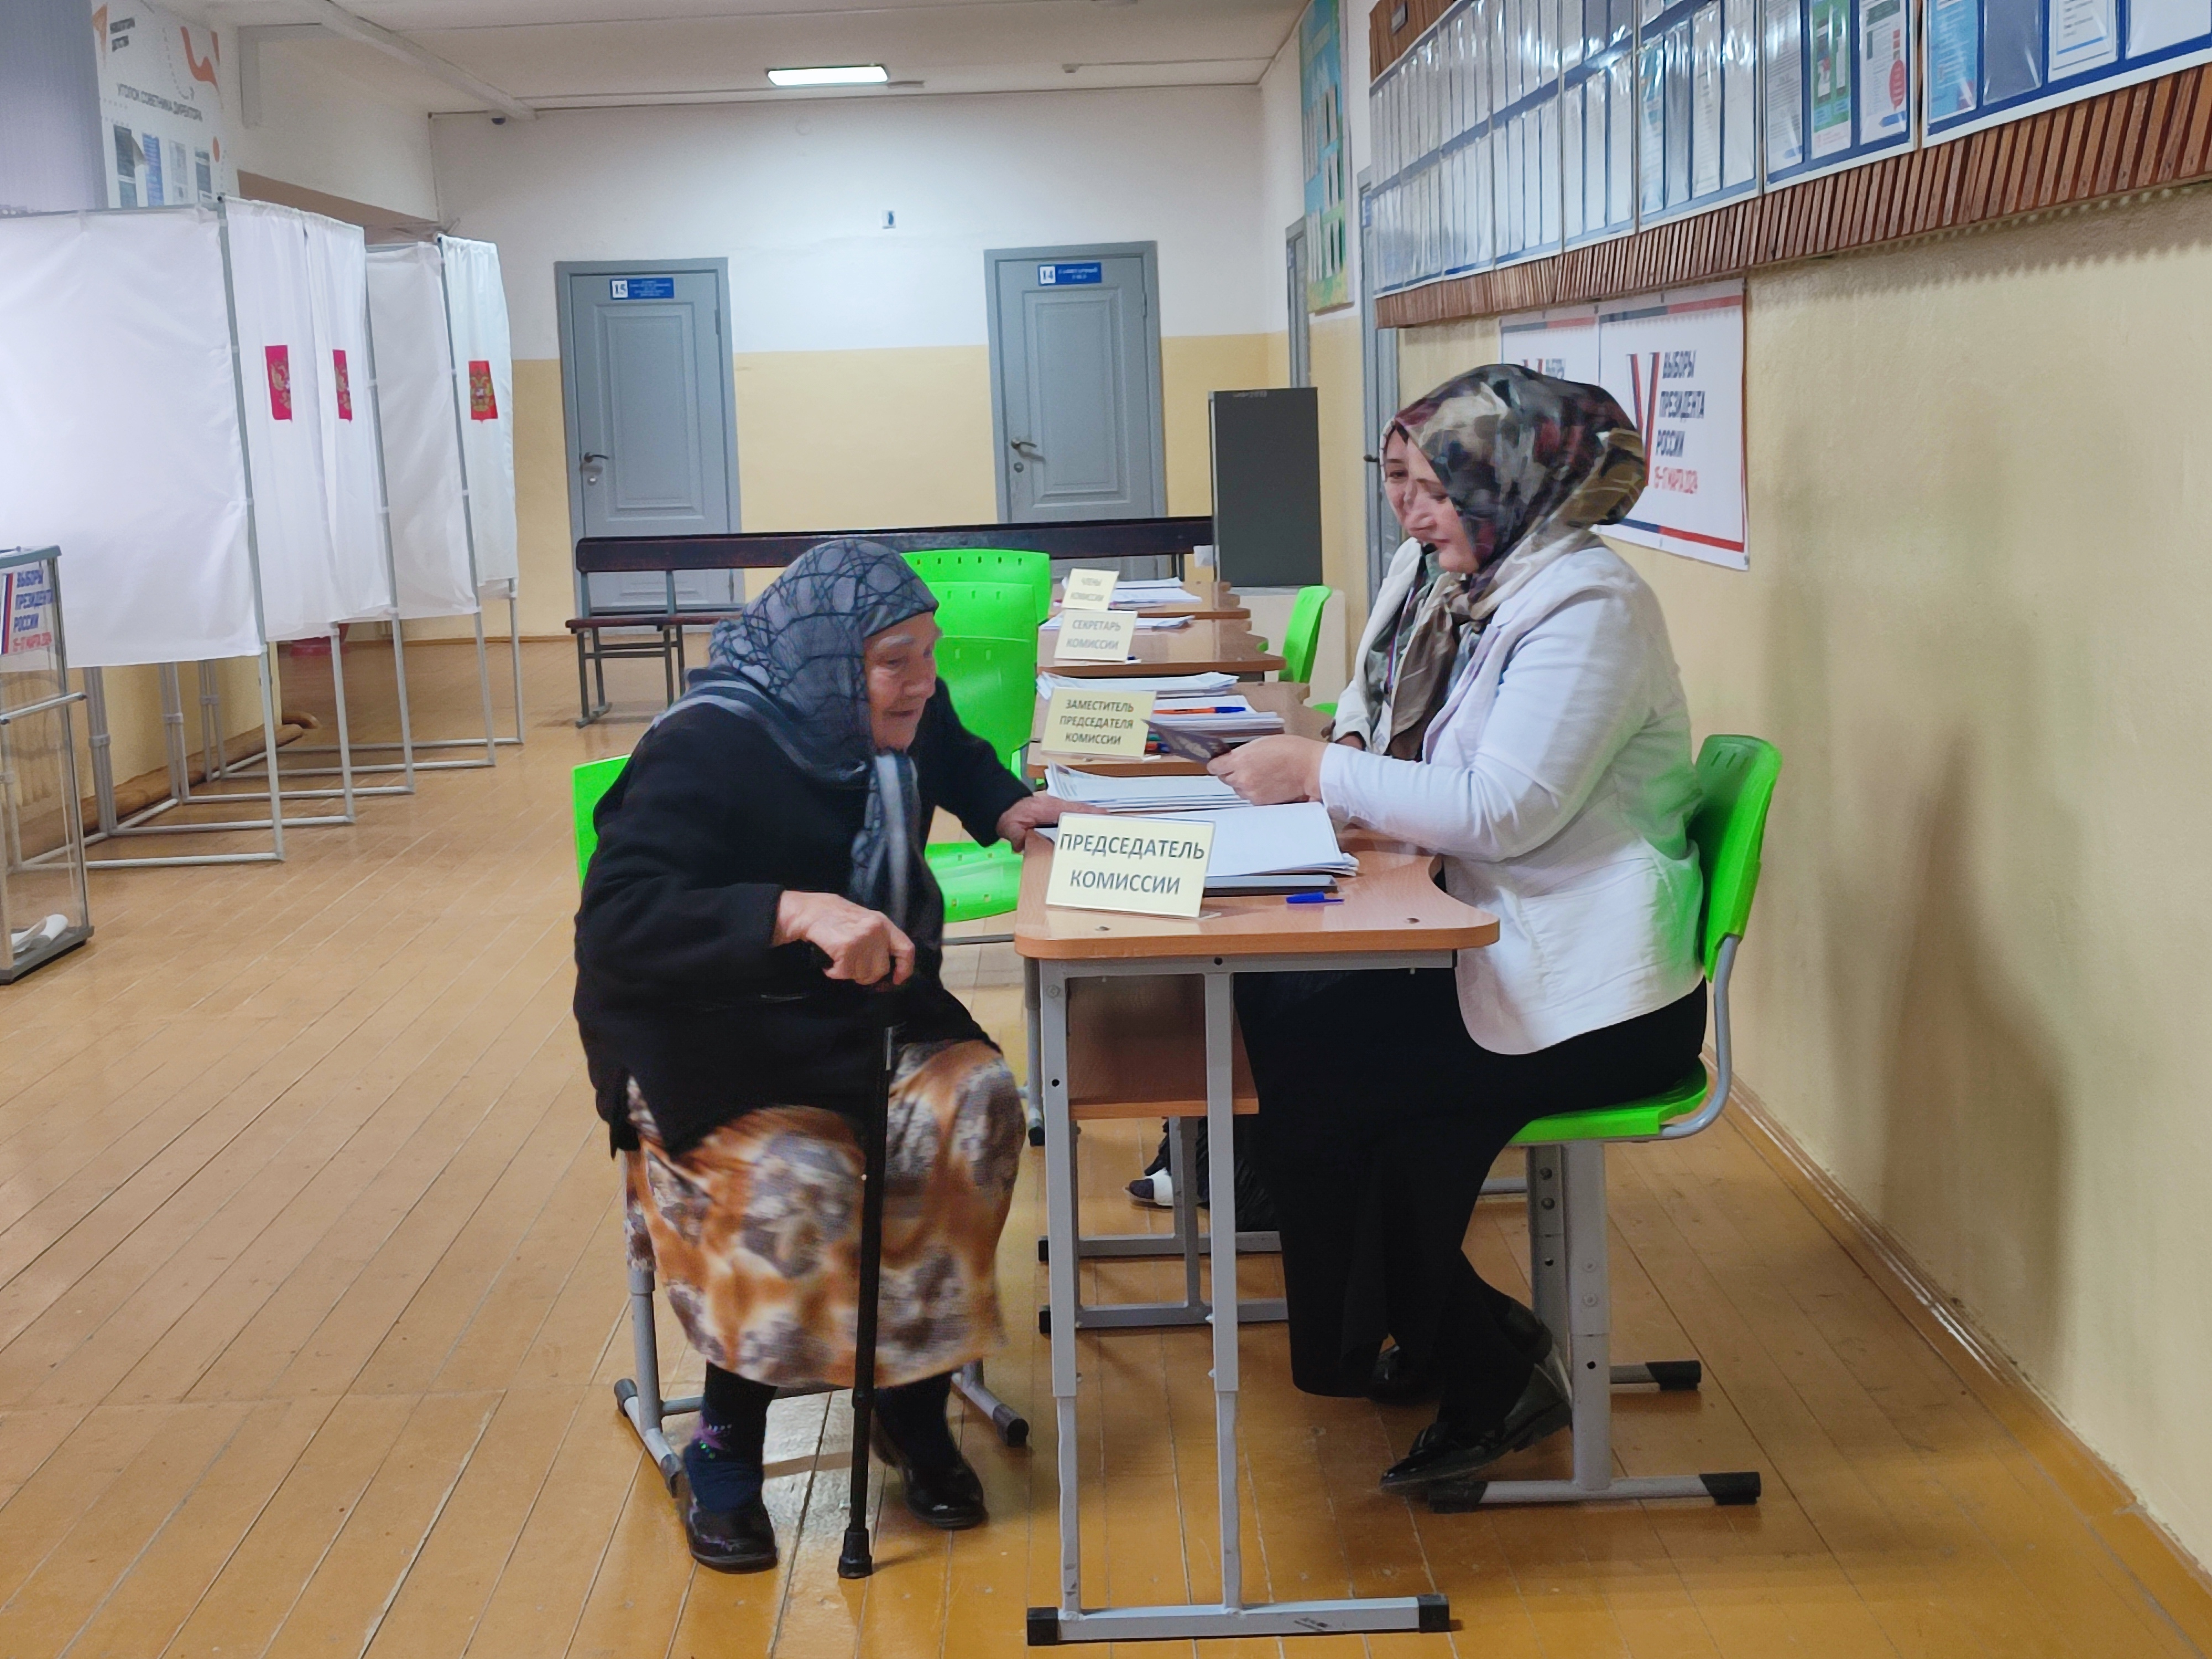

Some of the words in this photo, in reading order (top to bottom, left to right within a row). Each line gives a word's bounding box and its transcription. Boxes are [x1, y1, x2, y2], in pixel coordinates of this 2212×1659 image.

[1042, 270, 1053, 280] 14
[614, 284, 626, 295] 15
[1662, 349, 1697, 379] ВЫБОРЫ
[1659, 390, 1705, 422] ПРЕЗИДЕНТА
[1655, 429, 1686, 457] РОССИИ
[13, 613, 39, 633] РОССИИ
[1072, 619, 1121, 632] СЕКРЕТАРЬ
[1066, 638, 1119, 650] КОМИССИИ
[1066, 699, 1134, 713] ЗАМЕСТИТЕЛЬ
[1059, 715, 1134, 729] ПРЕДСЕДАТЕЛЯ
[1065, 732, 1121, 745] КОМИССИИ
[1059, 833, 1205, 860] ПРЕДСЕДАТЕЛЬ
[1070, 869, 1181, 895] КОМИССИИ
